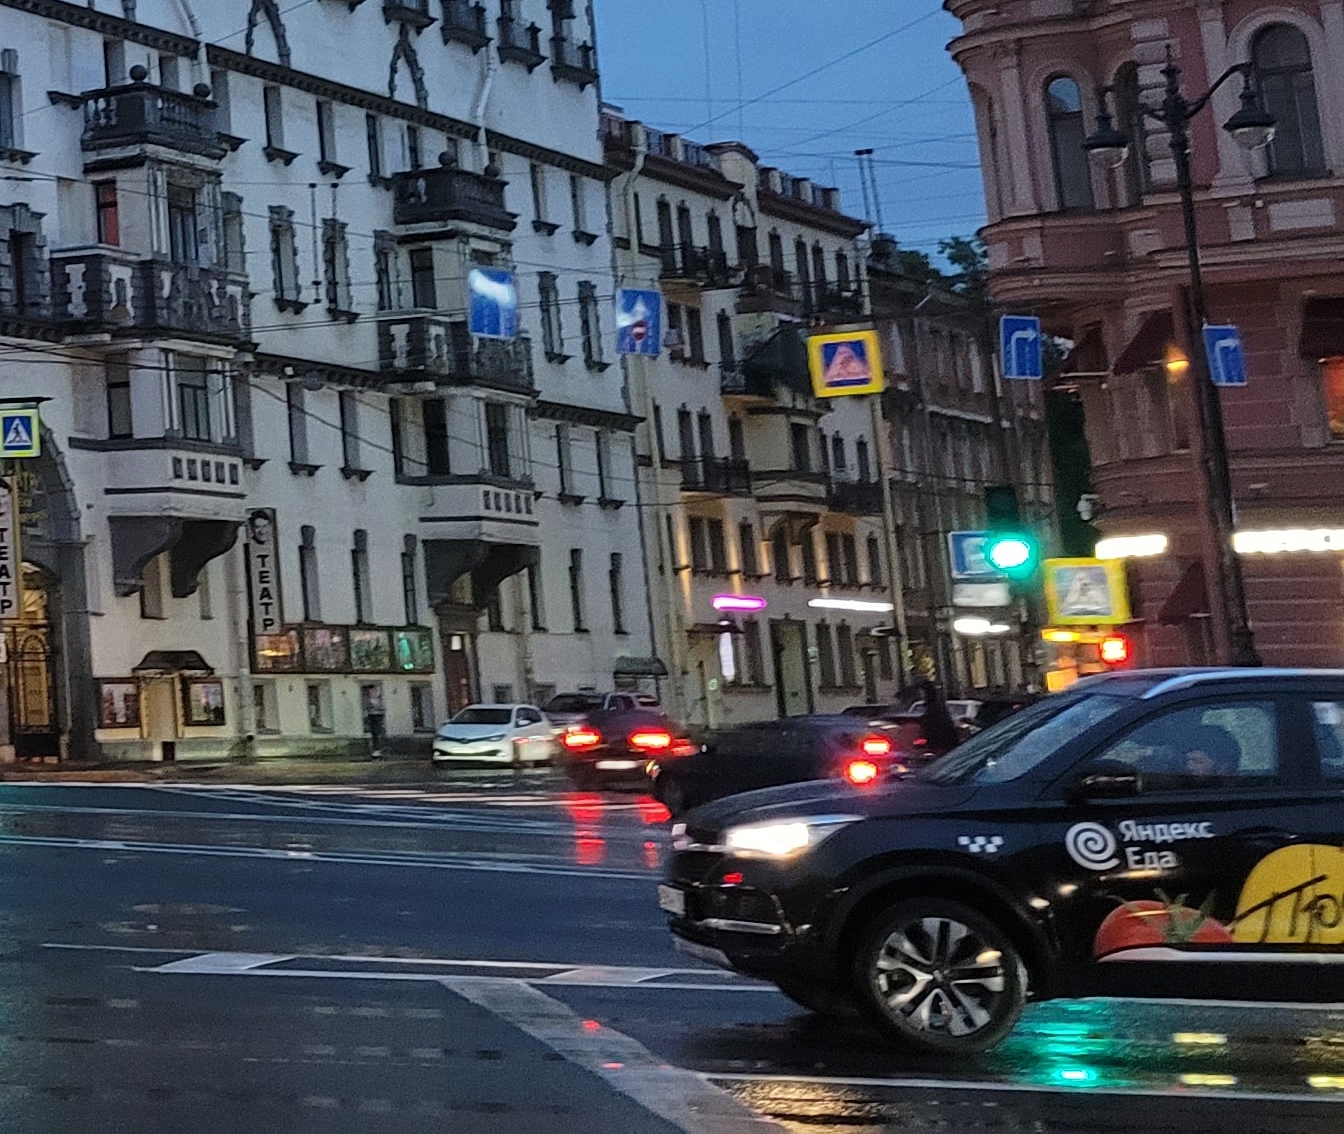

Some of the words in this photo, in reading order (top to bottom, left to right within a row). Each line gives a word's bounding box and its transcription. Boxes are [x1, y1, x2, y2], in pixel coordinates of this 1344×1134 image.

[256, 554, 274, 632] ТЕАТР
[1118, 819, 1216, 844] Яндекс
[1125, 847, 1176, 870] Еда
